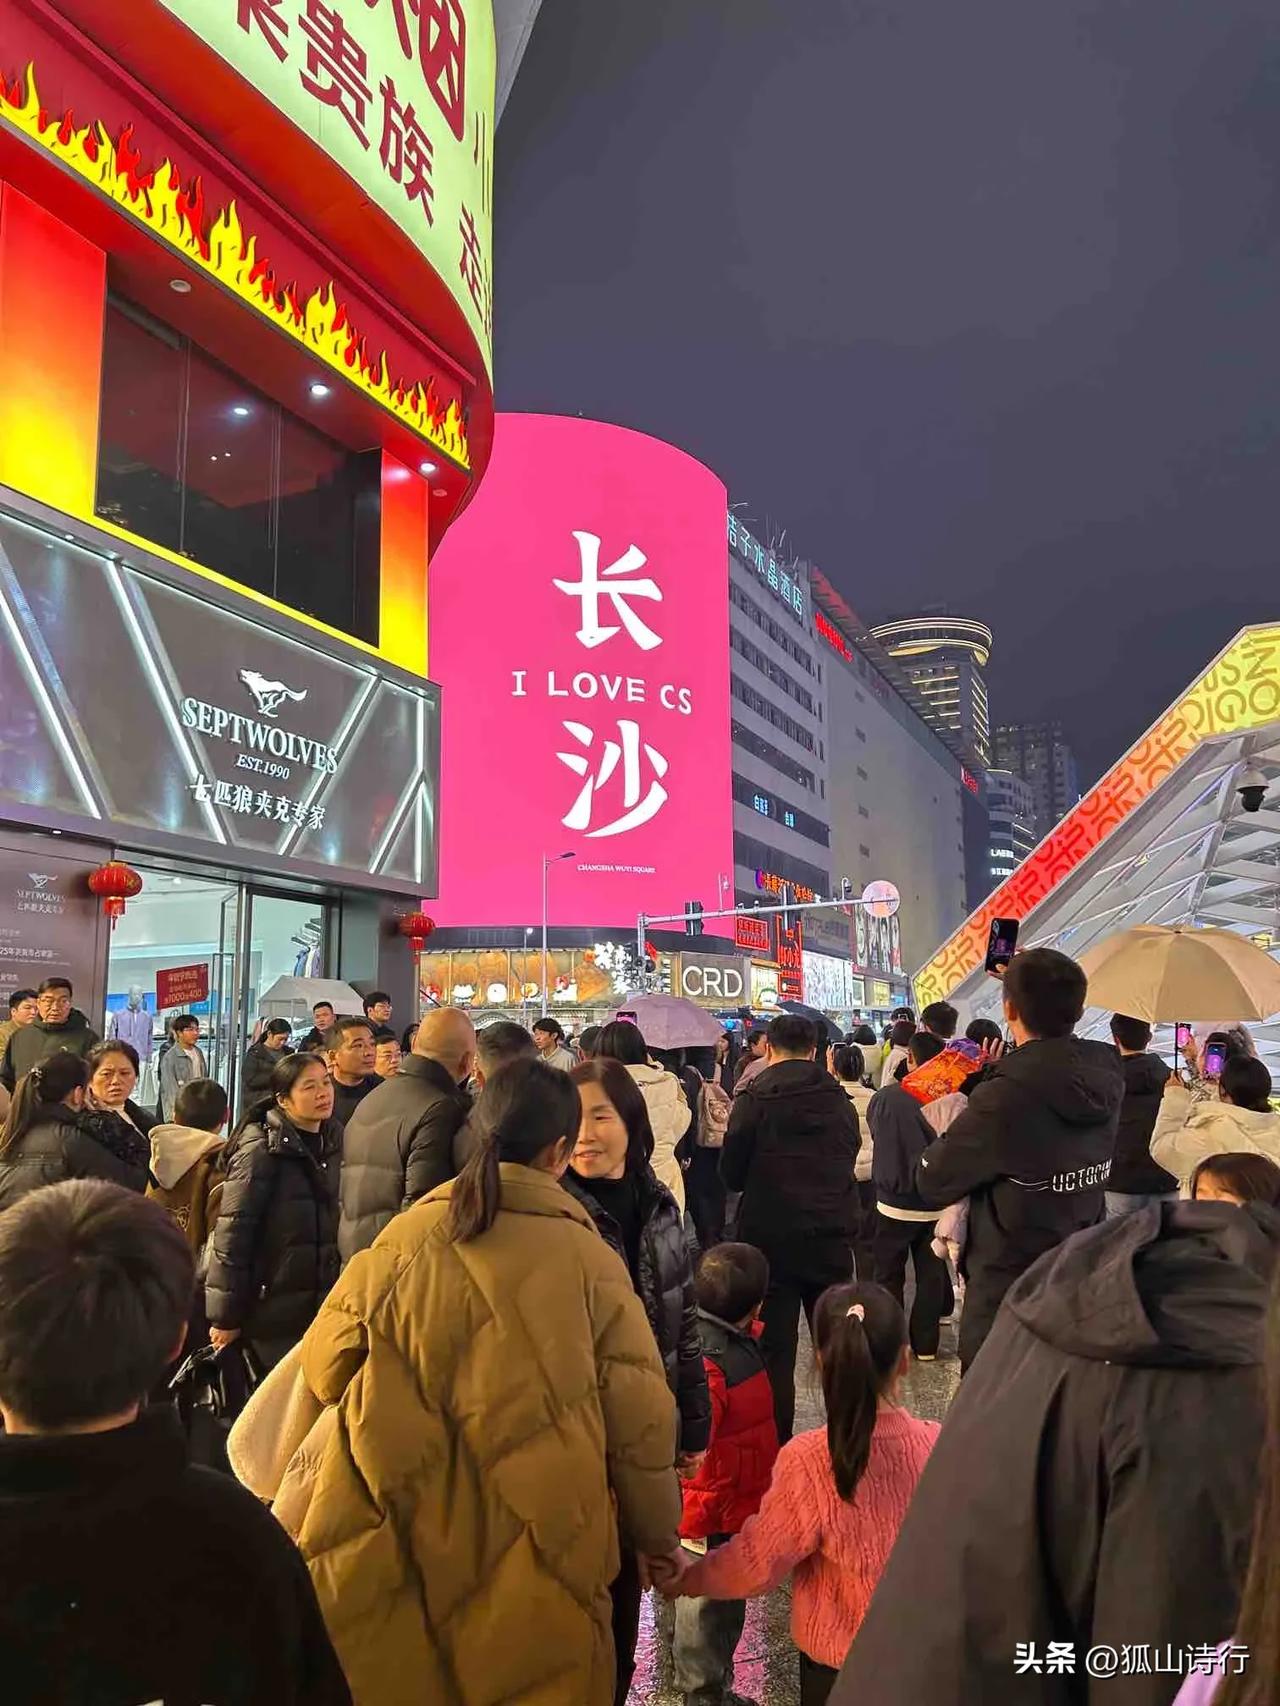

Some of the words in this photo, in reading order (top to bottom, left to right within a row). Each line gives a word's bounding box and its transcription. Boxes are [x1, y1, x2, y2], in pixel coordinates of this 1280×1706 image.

[552, 530, 663, 651] 长
[512, 671, 527, 696] I
[548, 671, 645, 702] LOVE
[660, 684, 692, 714] CS
[182, 697, 338, 775] SEPTWOLVES
[236, 753, 290, 780] EST.1990
[556, 719, 669, 838] 沙
[189, 774, 326, 830] 七匹狼夹克专家
[682, 965, 743, 998] CRD
